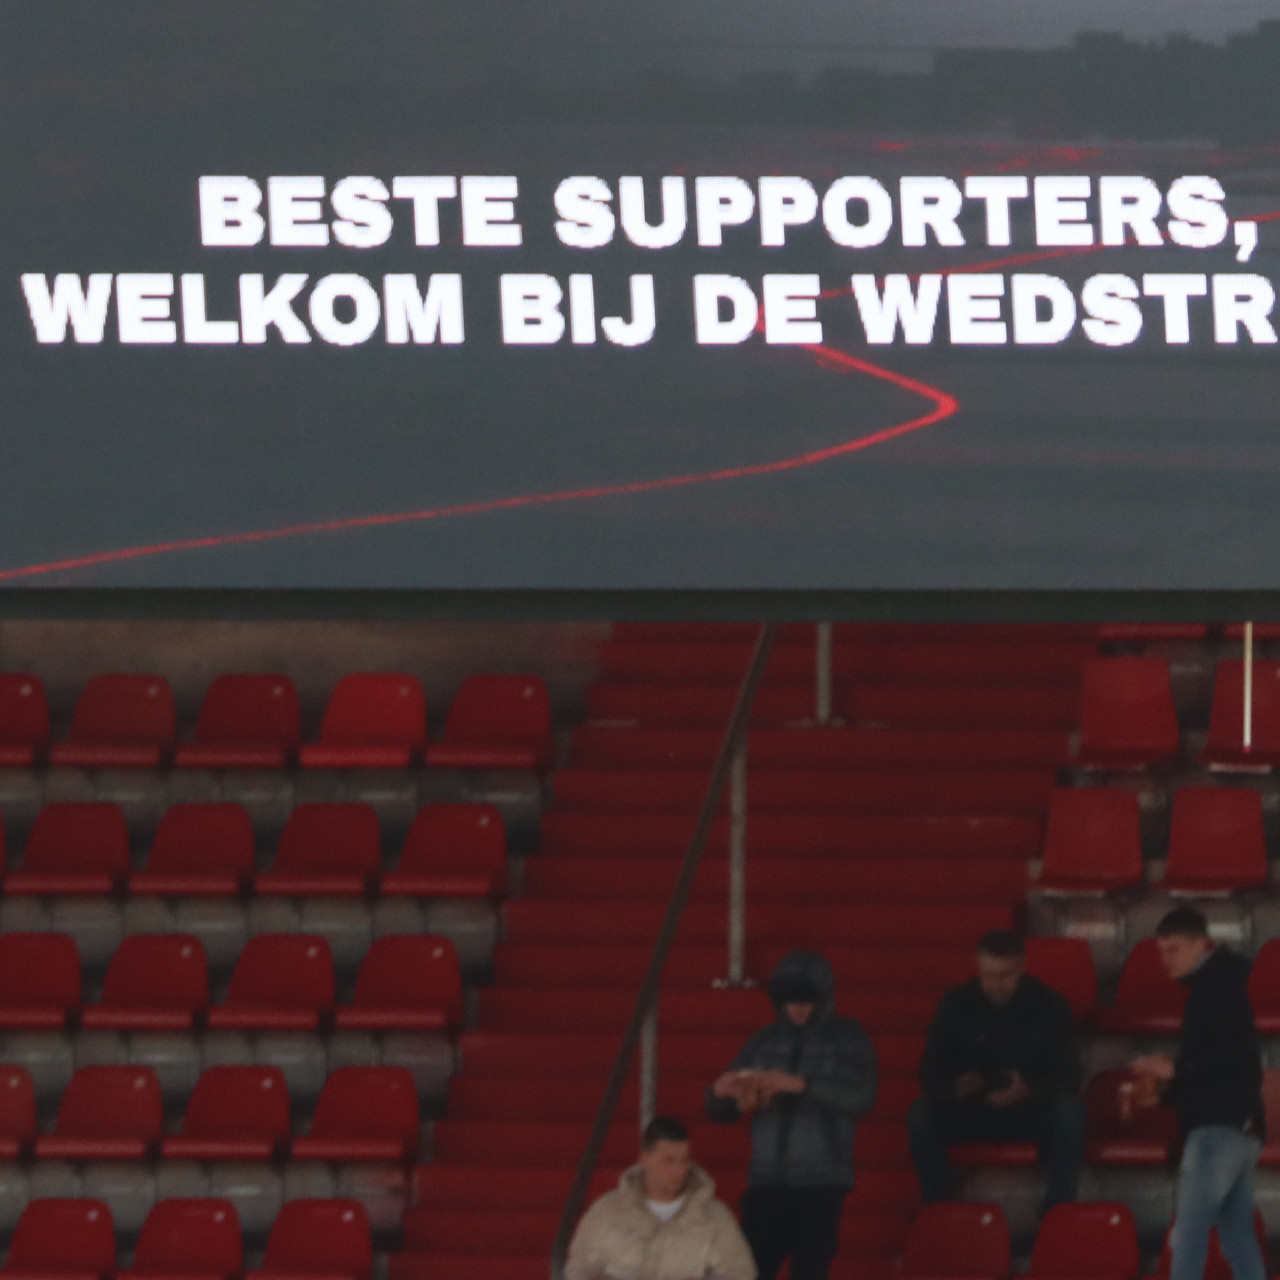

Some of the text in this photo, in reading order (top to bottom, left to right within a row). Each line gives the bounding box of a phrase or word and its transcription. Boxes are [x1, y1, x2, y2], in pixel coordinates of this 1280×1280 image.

[198, 175, 1258, 263] BESTE SUPPORTERS,
[20, 273, 465, 346] WELKOM
[500, 273, 656, 347] BIJ
[693, 273, 823, 344] DE
